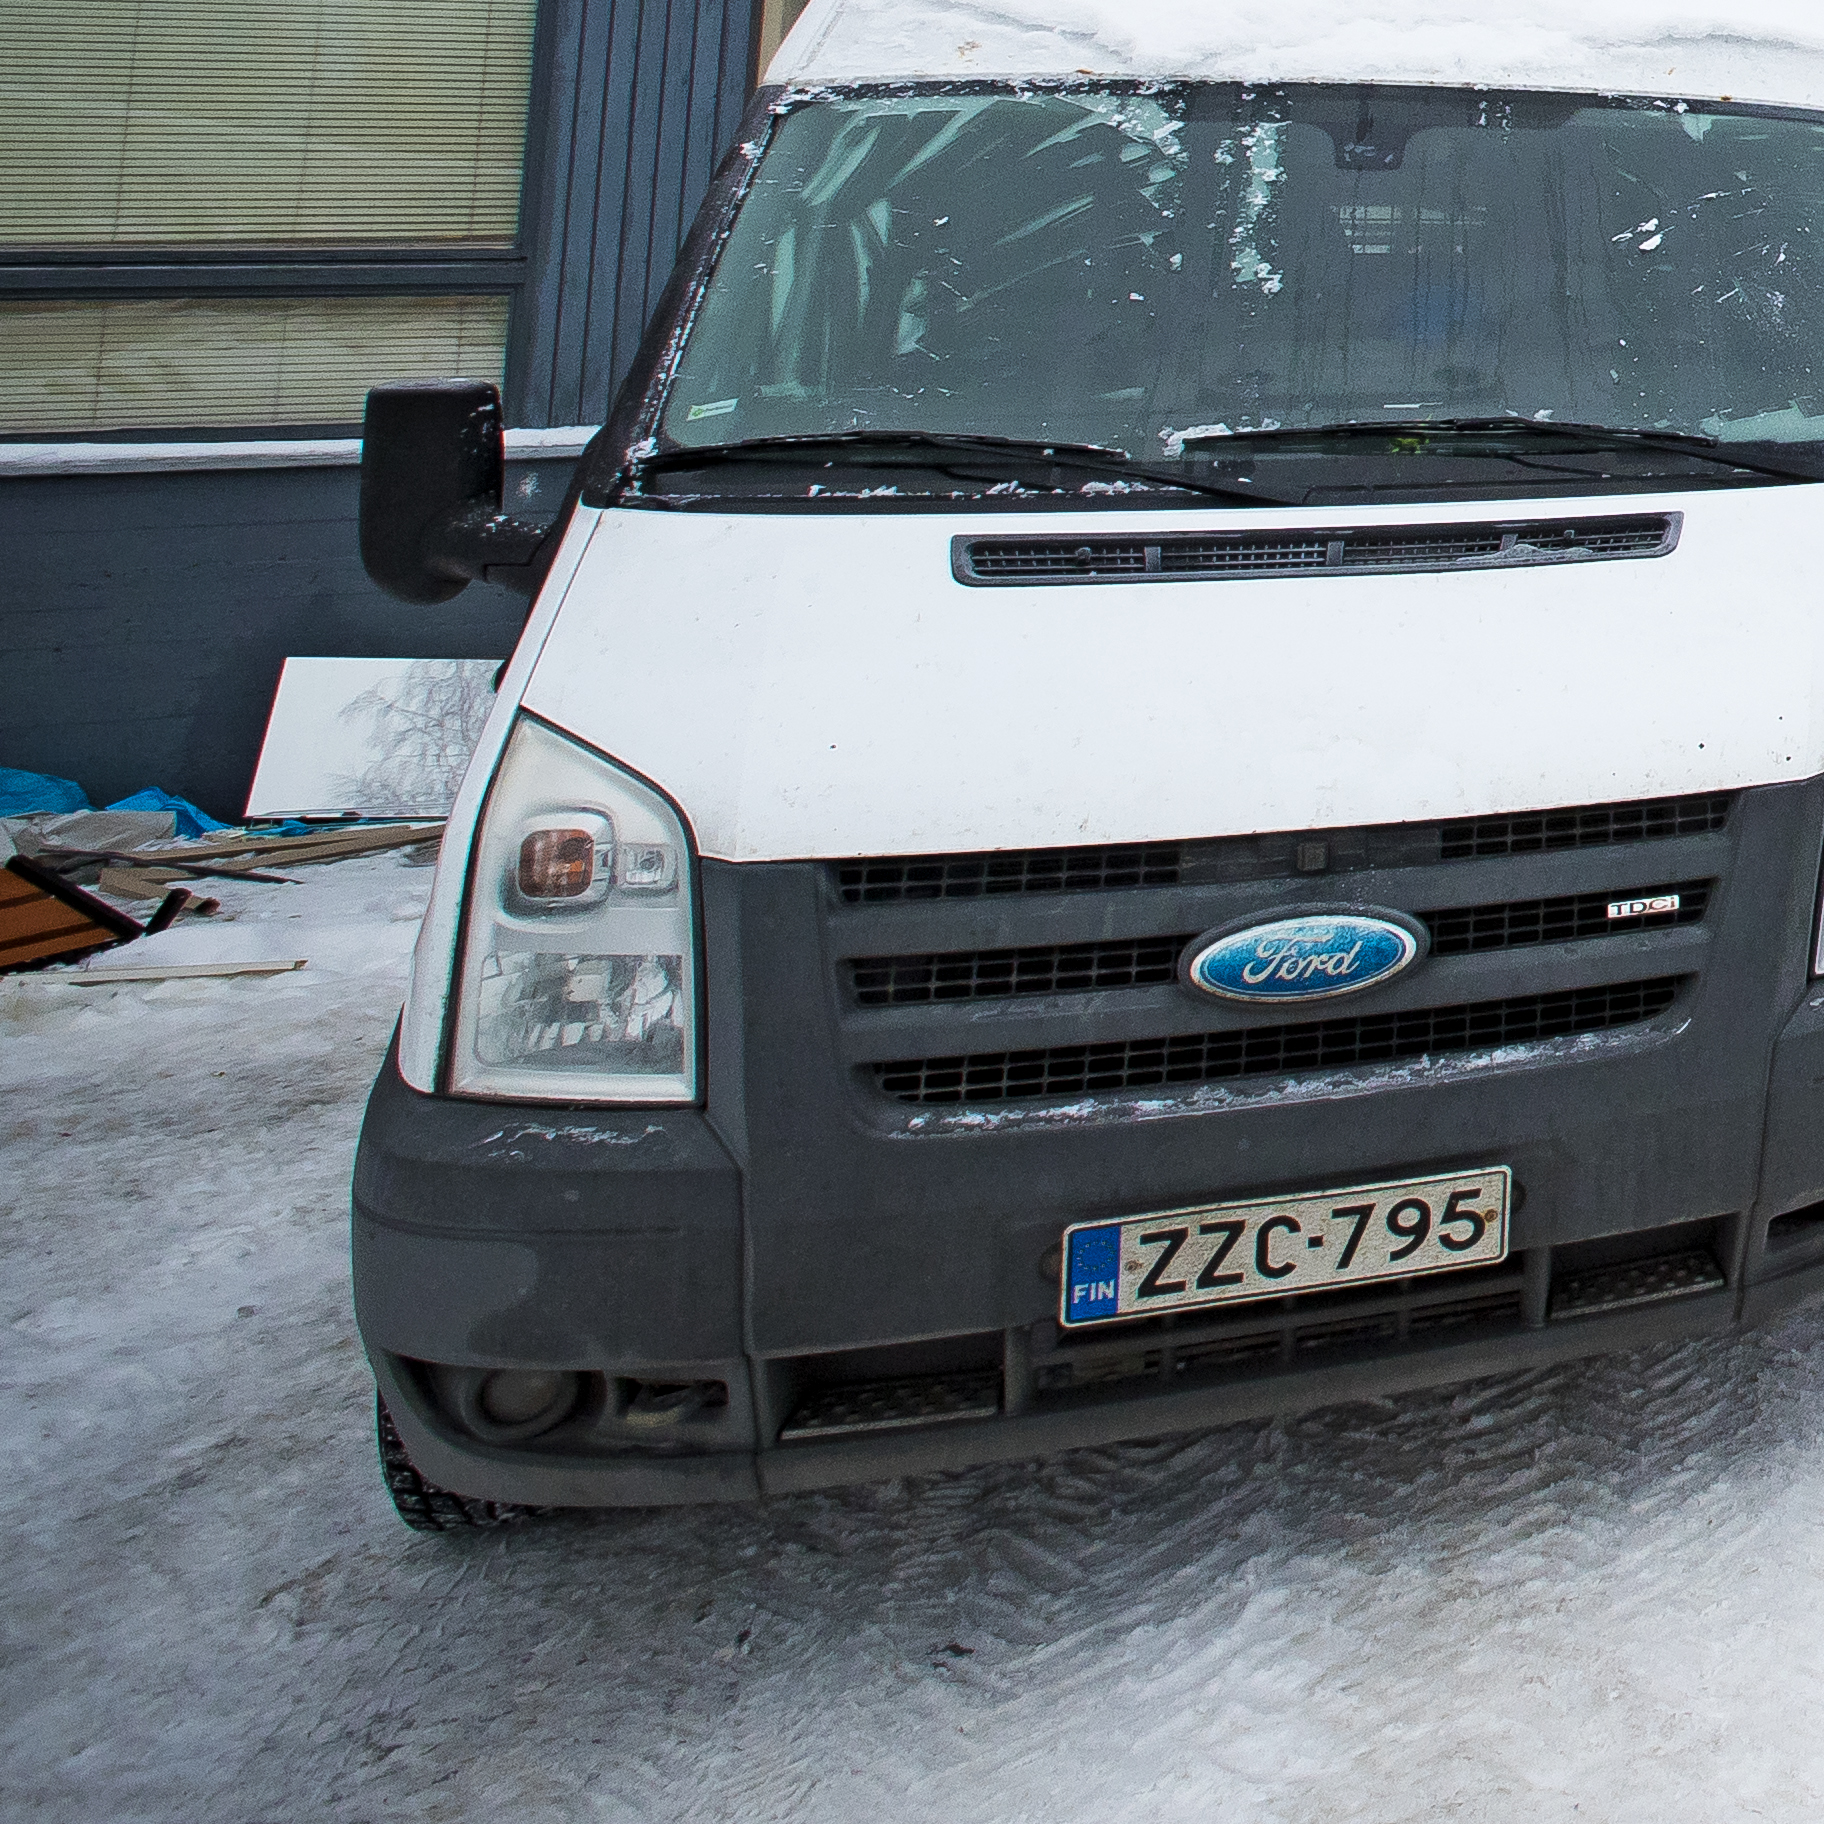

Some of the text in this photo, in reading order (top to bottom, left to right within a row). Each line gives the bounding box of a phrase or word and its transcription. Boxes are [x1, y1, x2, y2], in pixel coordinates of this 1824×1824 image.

[1610, 896, 1676, 916] TDCi
[1242, 932, 1364, 984] Ford
[1135, 1187, 1487, 1299] ZZC-795
[1072, 1279, 1116, 1305] FIN
